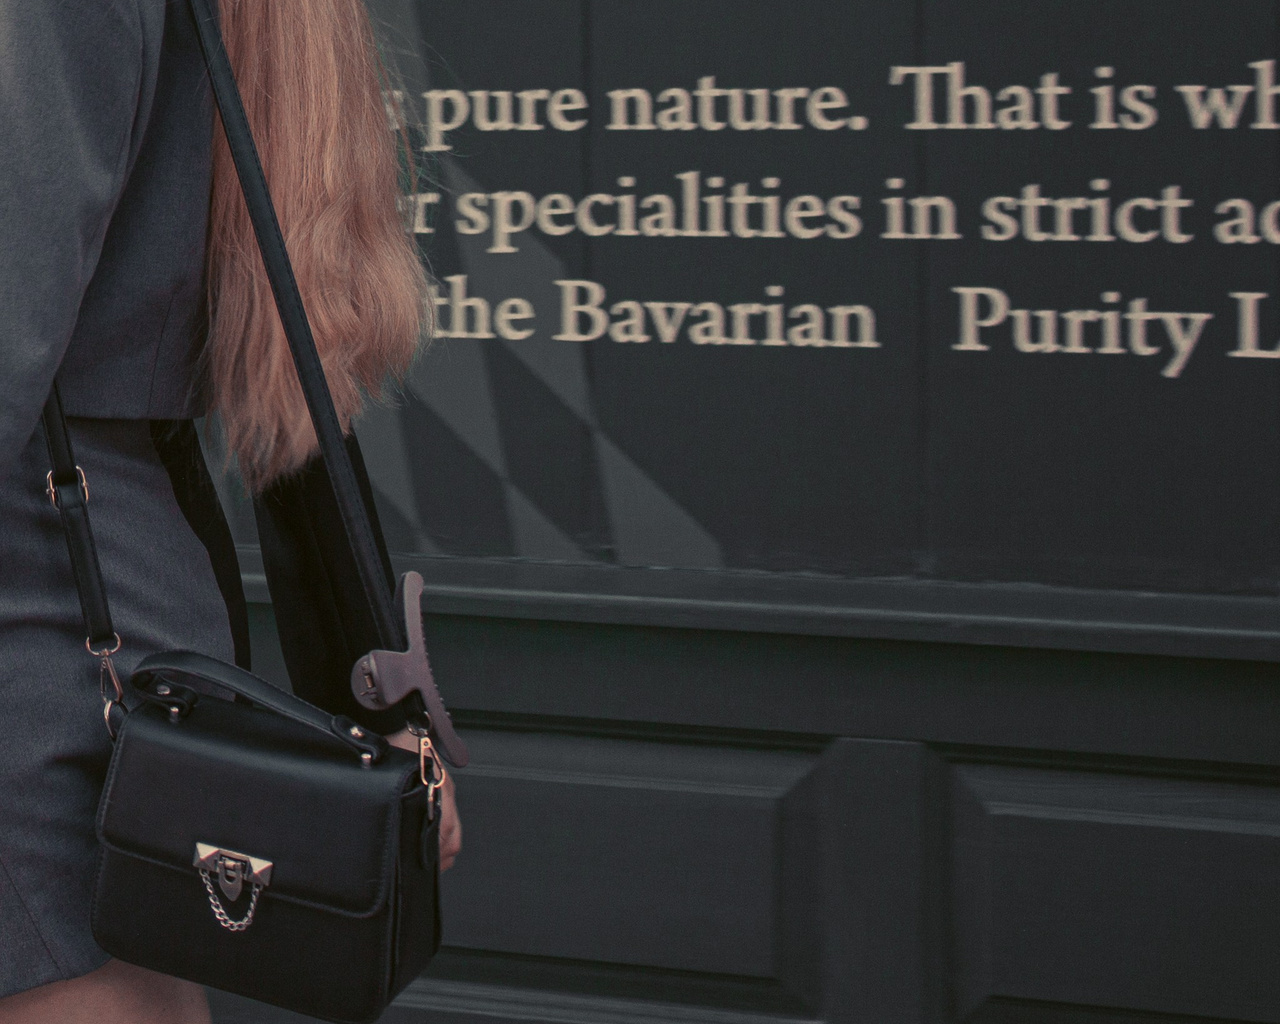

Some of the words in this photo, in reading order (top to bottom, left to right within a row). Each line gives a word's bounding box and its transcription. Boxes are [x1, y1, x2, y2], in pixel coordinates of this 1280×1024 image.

[421, 88, 586, 152] pure
[607, 77, 868, 131] nature.
[890, 62, 1071, 130] That
[1091, 66, 1157, 130] is
[455, 171, 862, 253] specialities
[881, 178, 961, 239] in
[982, 179, 1193, 244] strict
[427, 274, 536, 341] the
[551, 279, 880, 348] Bavarian
[952, 287, 1215, 378] Purity
